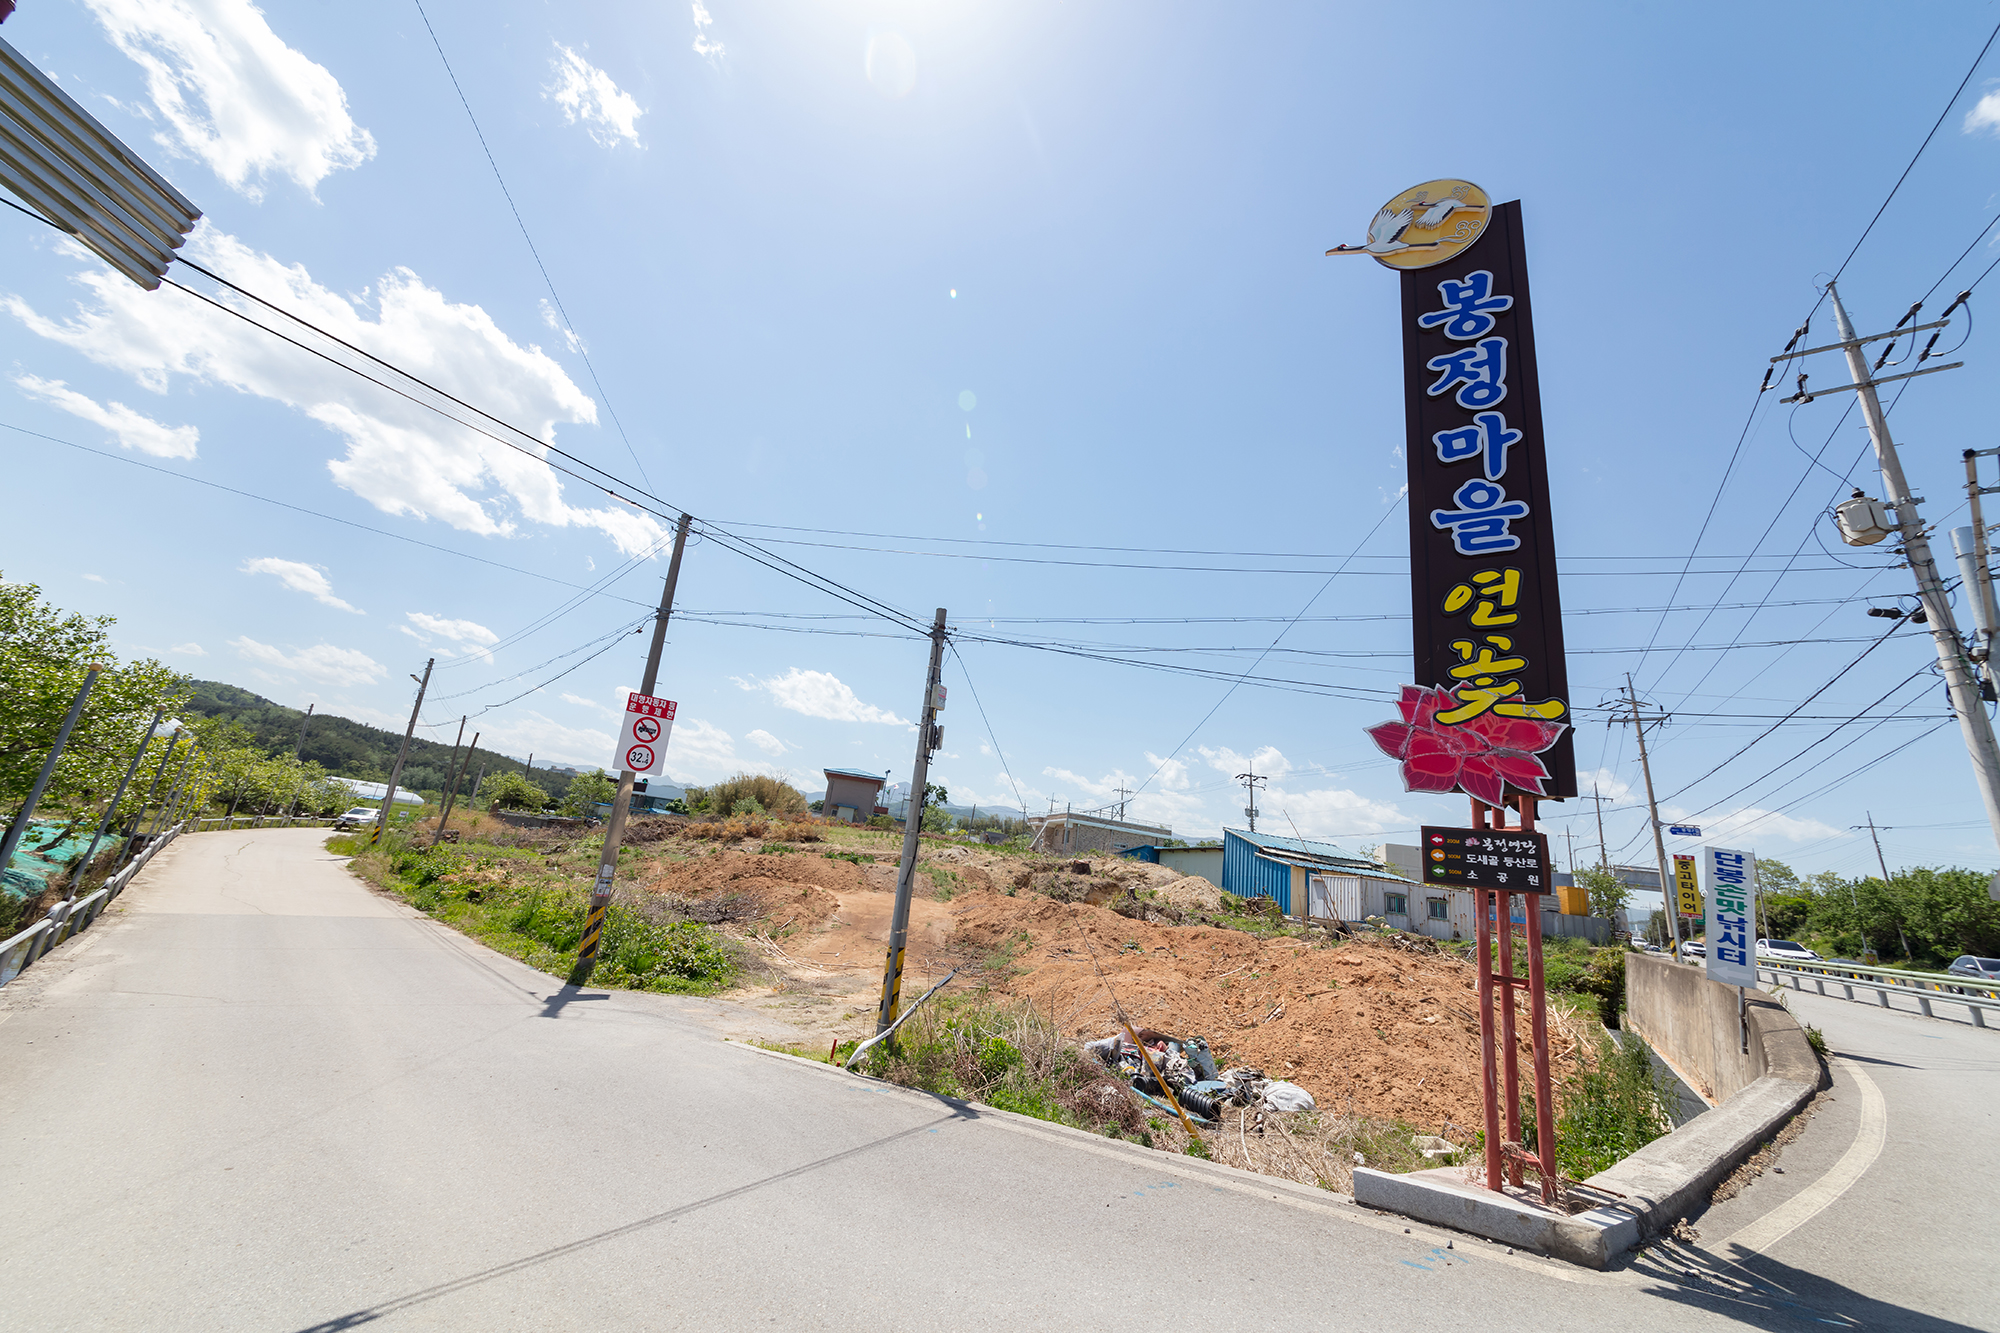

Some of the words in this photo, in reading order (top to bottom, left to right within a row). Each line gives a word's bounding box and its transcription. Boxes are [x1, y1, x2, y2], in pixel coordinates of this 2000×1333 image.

[1417, 270, 1530, 556] 봉정마을
[1433, 566, 1568, 727] 연꽃
[1503, 856, 1539, 868] 등산로
[1678, 860, 1697, 913] 중고타이어
